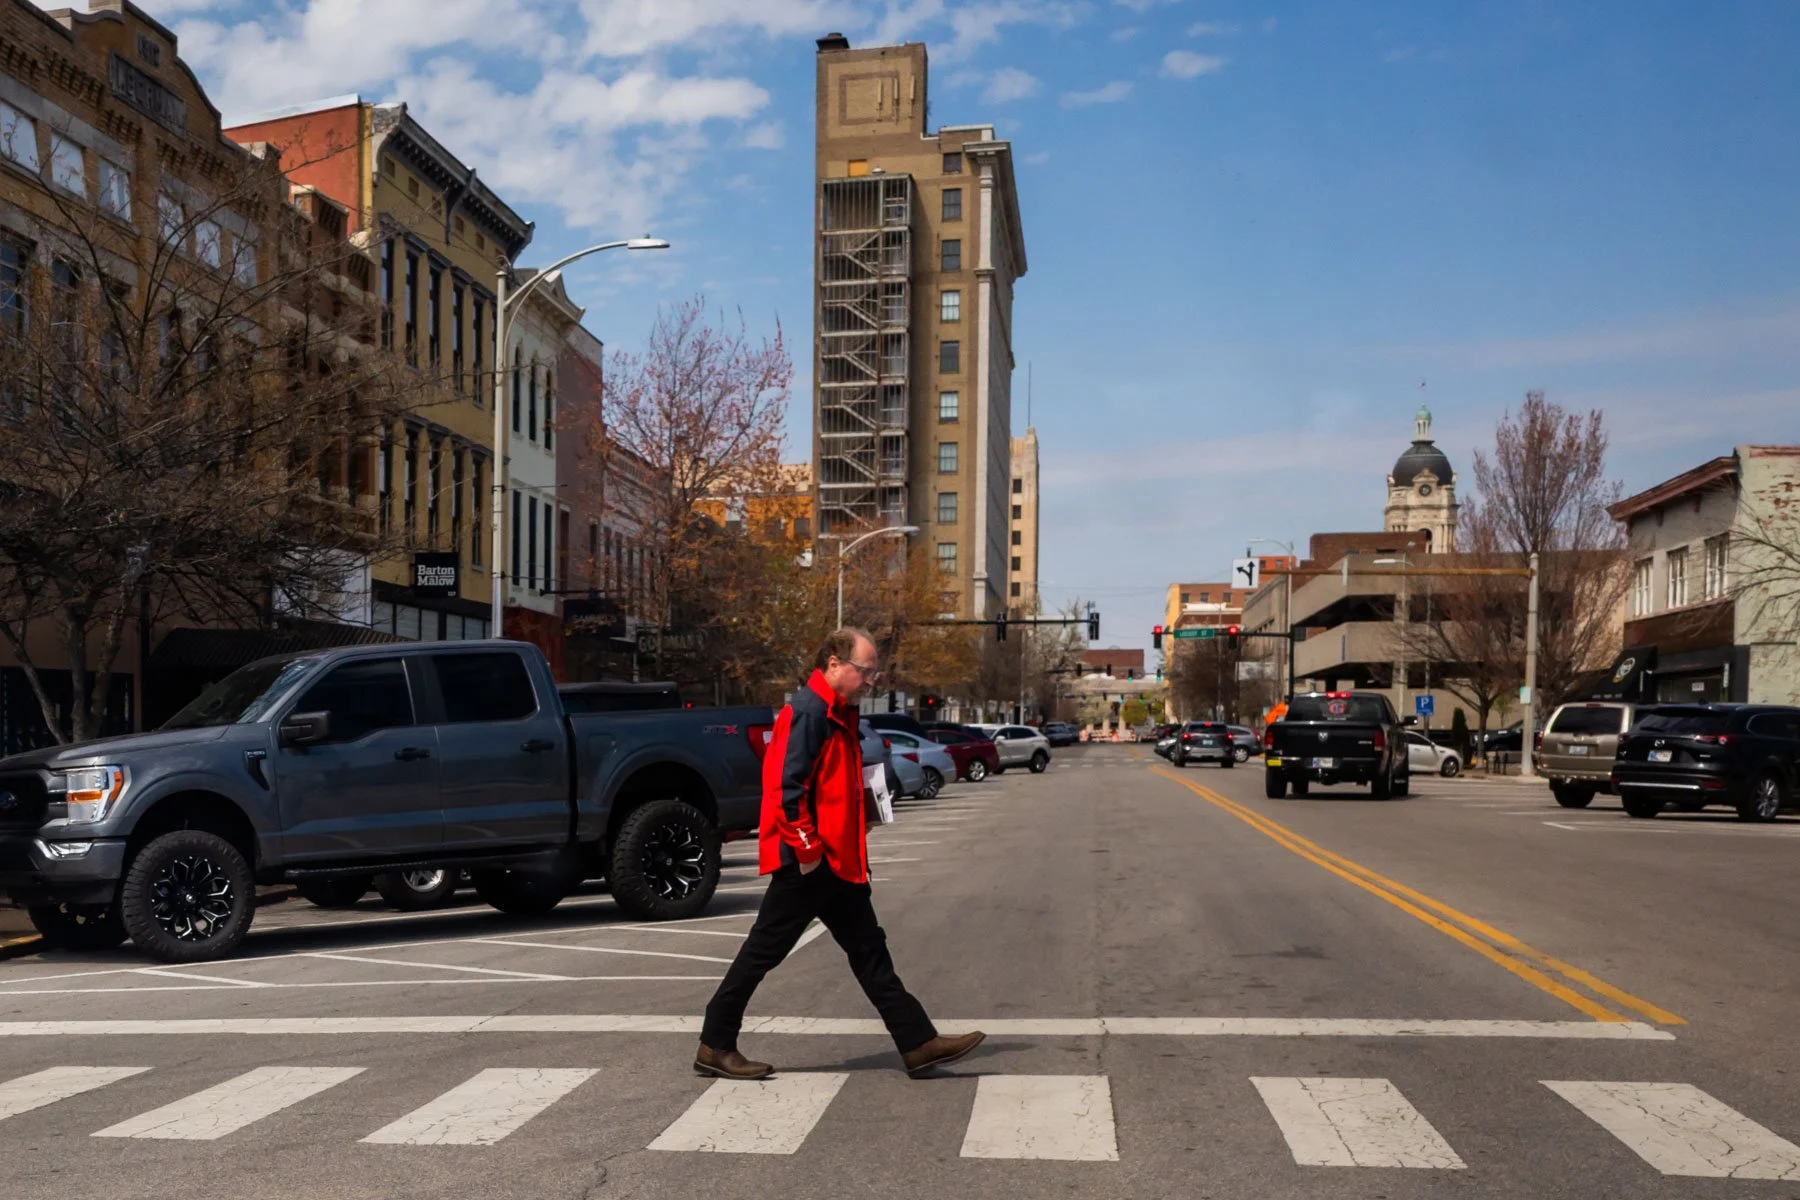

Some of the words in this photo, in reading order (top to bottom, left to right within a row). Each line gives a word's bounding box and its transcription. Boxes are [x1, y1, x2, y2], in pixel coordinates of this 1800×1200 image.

[417, 564, 455, 575] Barton
[417, 576, 455, 586] Malow
[638, 629, 708, 653] GODMAN'S
[1420, 696, 1430, 708] P
